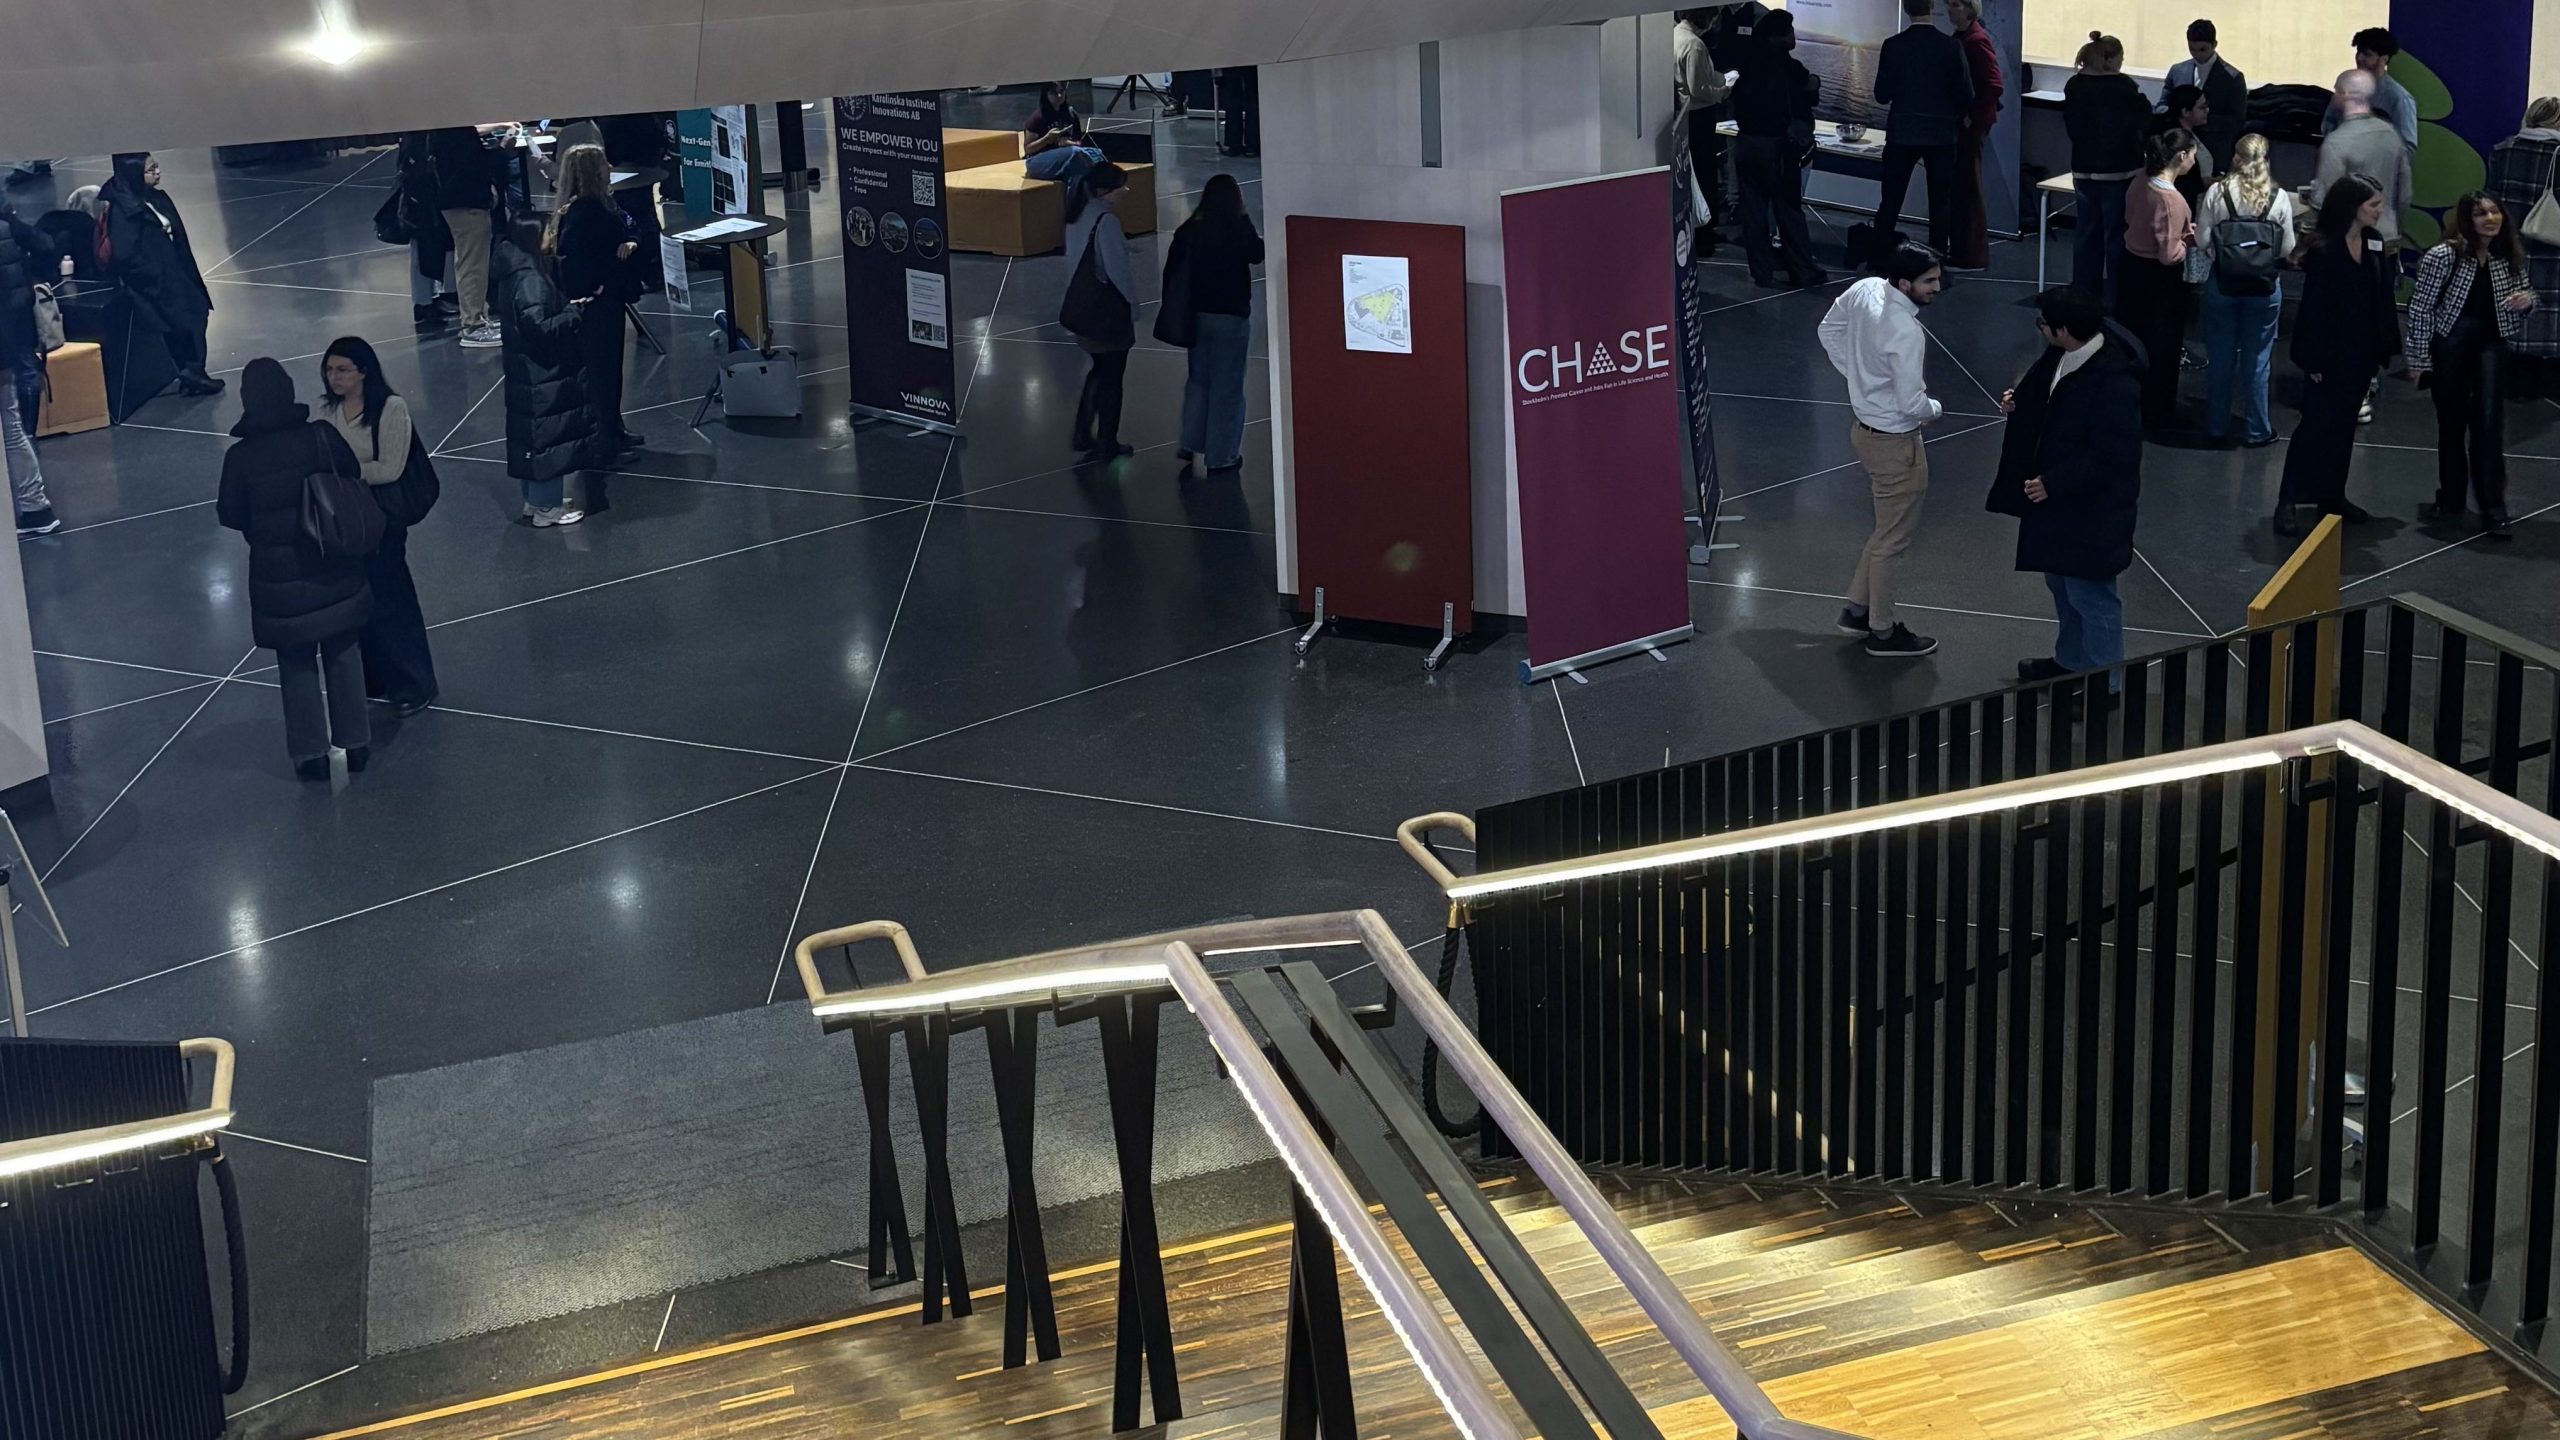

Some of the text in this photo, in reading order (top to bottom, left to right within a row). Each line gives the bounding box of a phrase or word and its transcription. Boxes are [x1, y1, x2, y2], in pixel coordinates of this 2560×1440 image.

[872, 94, 936, 111] Karolinska Institutet
[872, 105, 921, 120] Innovations AB
[840, 127, 938, 152] WE EMPOWER YOU
[842, 142, 862, 152] Create
[1518, 324, 1669, 393] CHASE
[1584, 385, 1593, 393] and
[900, 391, 950, 411] VINNOVA
